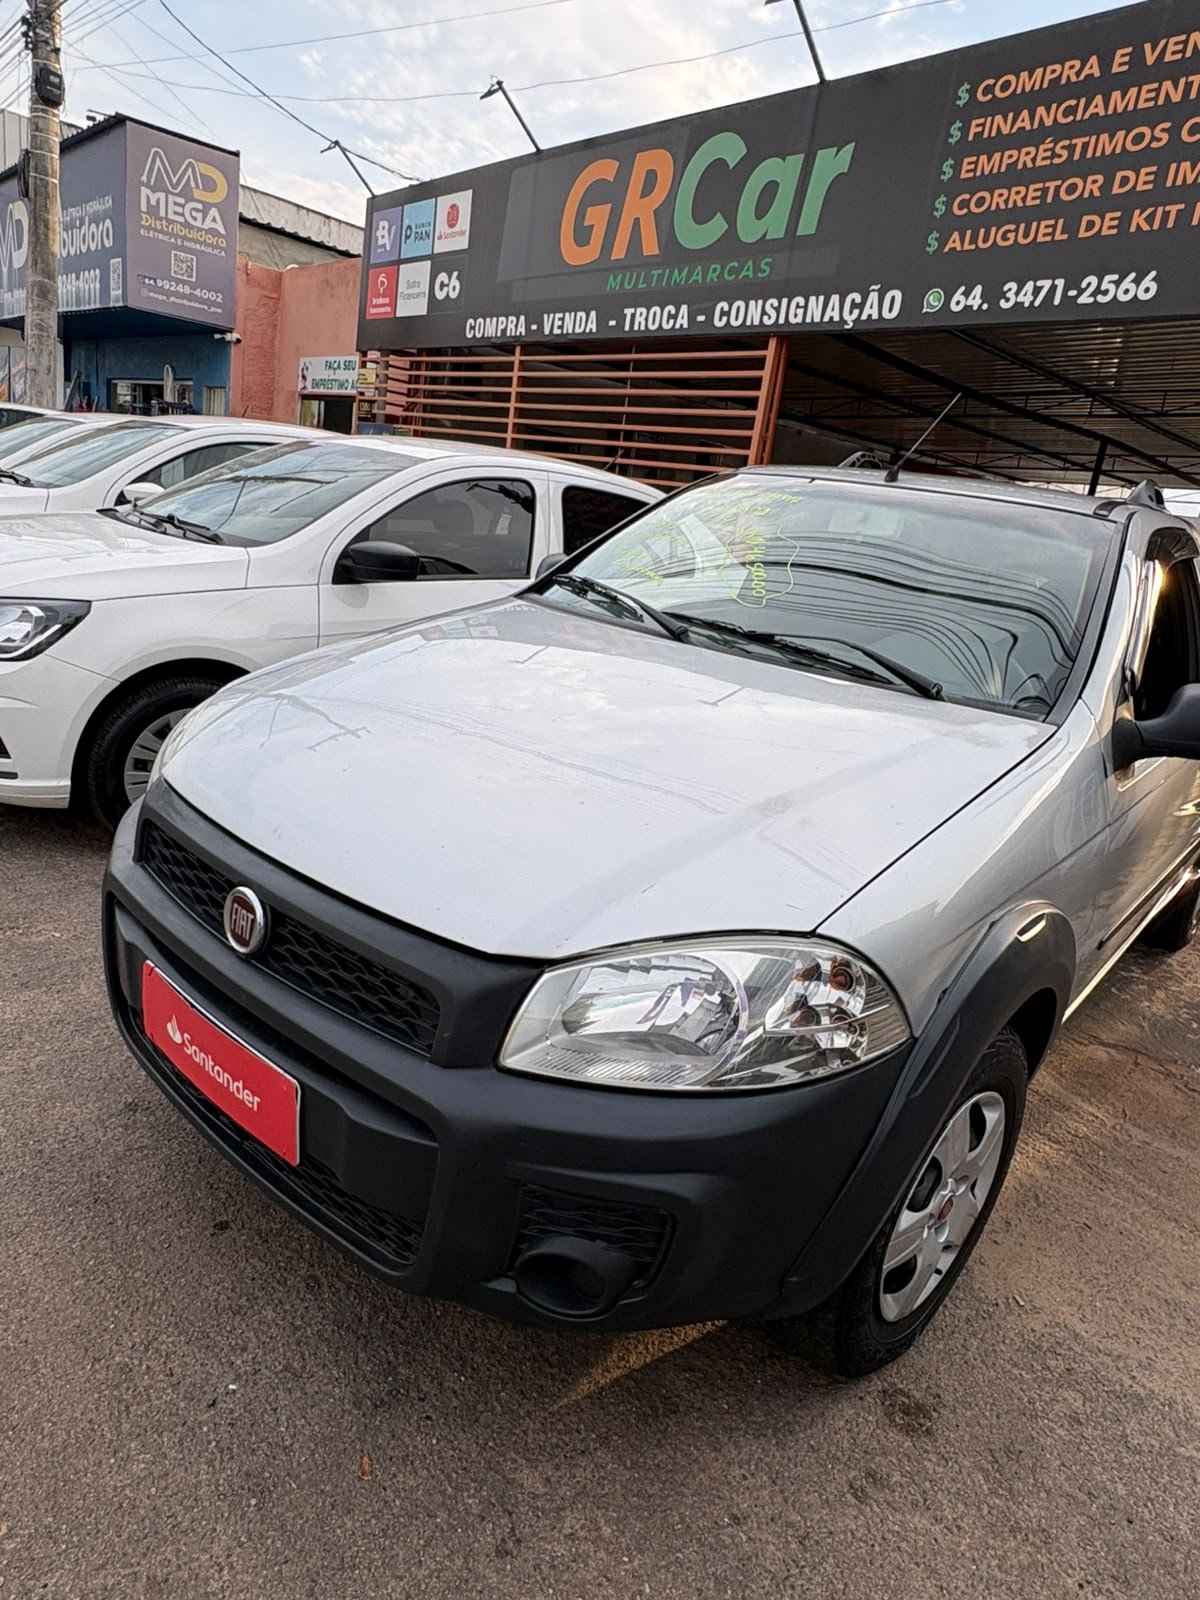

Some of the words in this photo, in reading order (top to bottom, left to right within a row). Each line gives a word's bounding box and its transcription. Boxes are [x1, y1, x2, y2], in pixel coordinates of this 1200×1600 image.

[976, 55, 1100, 102] COMPRA
[1111, 46, 1133, 73] E
[967, 74, 1200, 141] FINANCIAMENT
[959, 120, 1172, 179] EMPRÉSTIMOS
[140, 186, 227, 235] MEGA
[952, 174, 1104, 216] CORRETOR
[1111, 165, 1158, 195] DE
[140, 213, 226, 247] Distribuidora
[140, 228, 175, 244] ELÉTRICA
[184, 241, 226, 257] HIDRÁULICA
[414, 229, 431, 243] PAN
[943, 218, 1069, 253] ALUGUEL
[1077, 211, 1121, 238] DE
[1129, 203, 1185, 233] KIT
[434, 271, 460, 300] C6
[606, 257, 773, 292] MULTIMARCAS
[950, 285, 989, 312] 64.
[1000, 270, 1157, 309] 3471-2566
[465, 314, 526, 339] COMPRA
[543, 310, 597, 335] VENDA
[623, 304, 689, 332] TROCA
[713, 284, 902, 329] CONSIGNAÇÃO
[311, 374, 349, 391] EMPRÉSTIMO
[325, 359, 341, 376] FAÇA
[343, 359, 357, 371] SEU
[231, 902, 254, 940] FIAT
[183, 1032, 260, 1112] Santander
